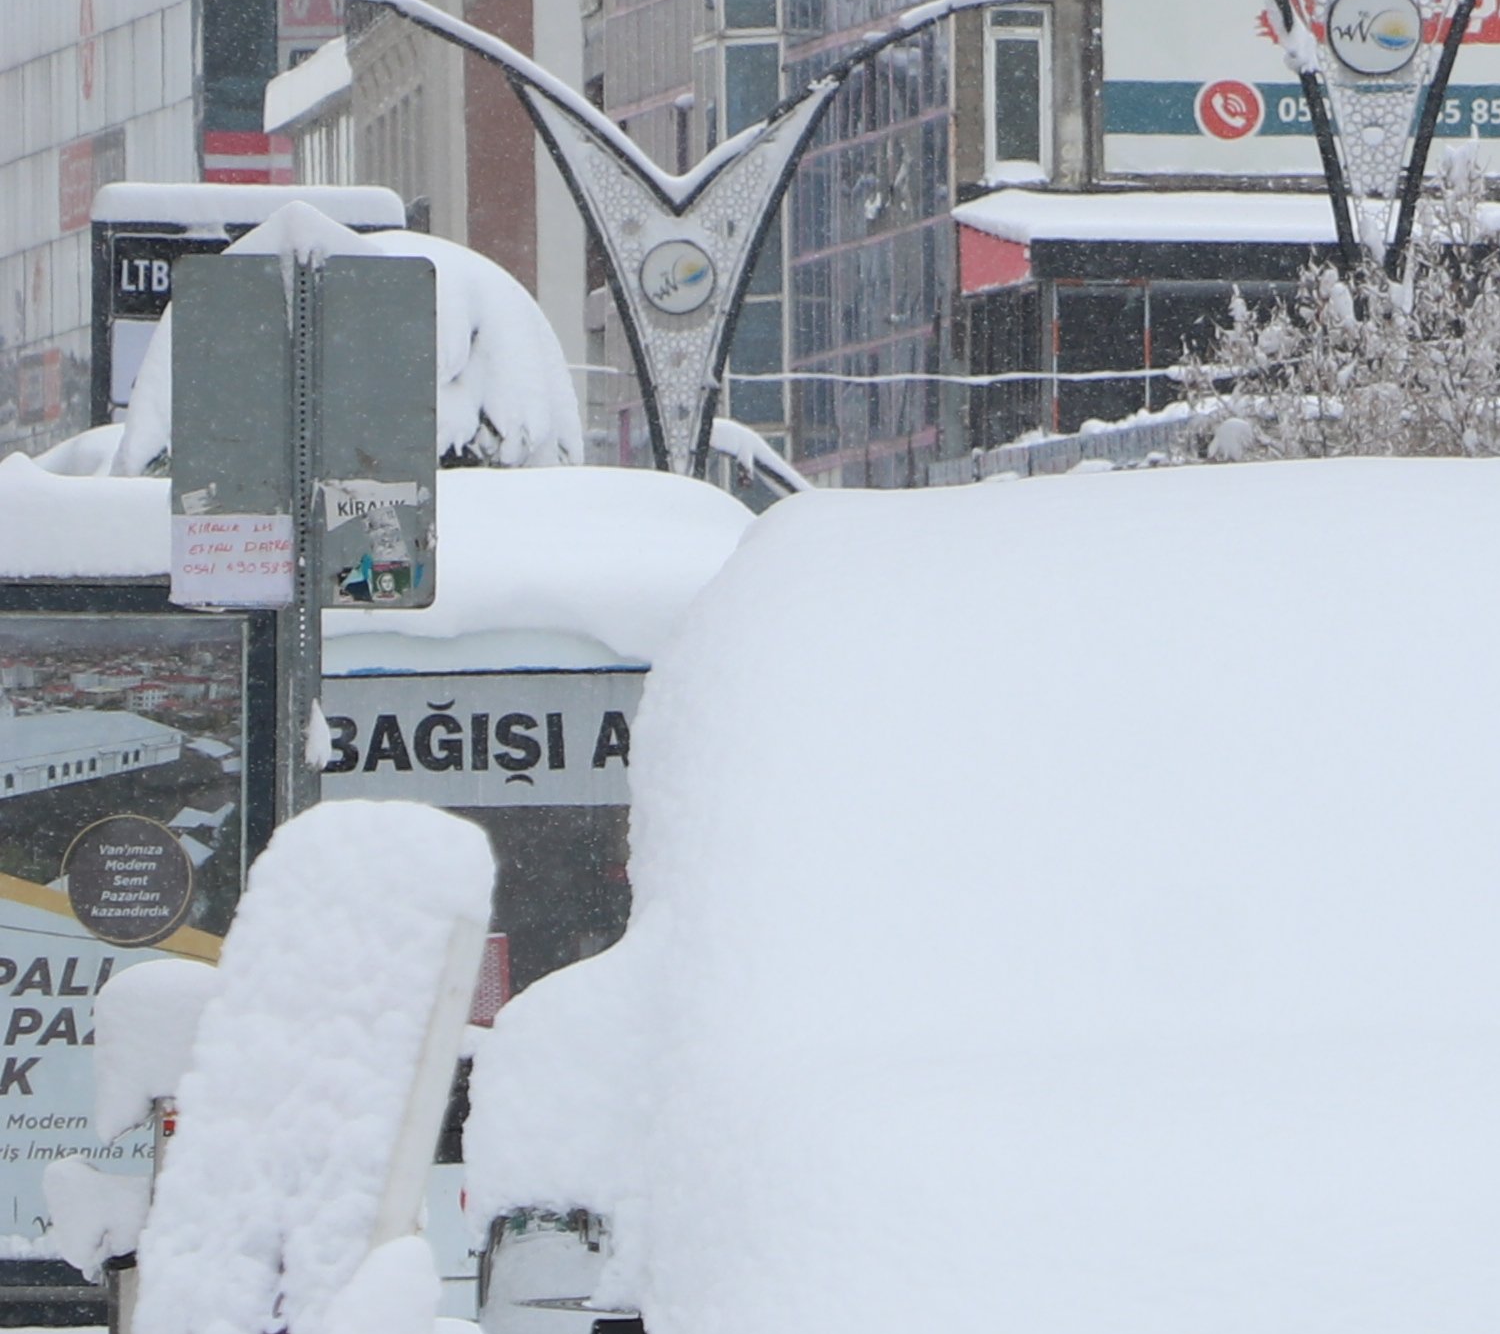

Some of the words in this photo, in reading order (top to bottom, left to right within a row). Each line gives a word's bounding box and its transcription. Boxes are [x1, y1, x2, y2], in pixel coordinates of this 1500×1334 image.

[104, 859, 157, 871] Modern
[113, 875, 149, 886] Semt
[100, 890, 161, 902] Pazarları
[90, 905, 171, 918] kazandırdık
[7, 1113, 88, 1129] Modern
